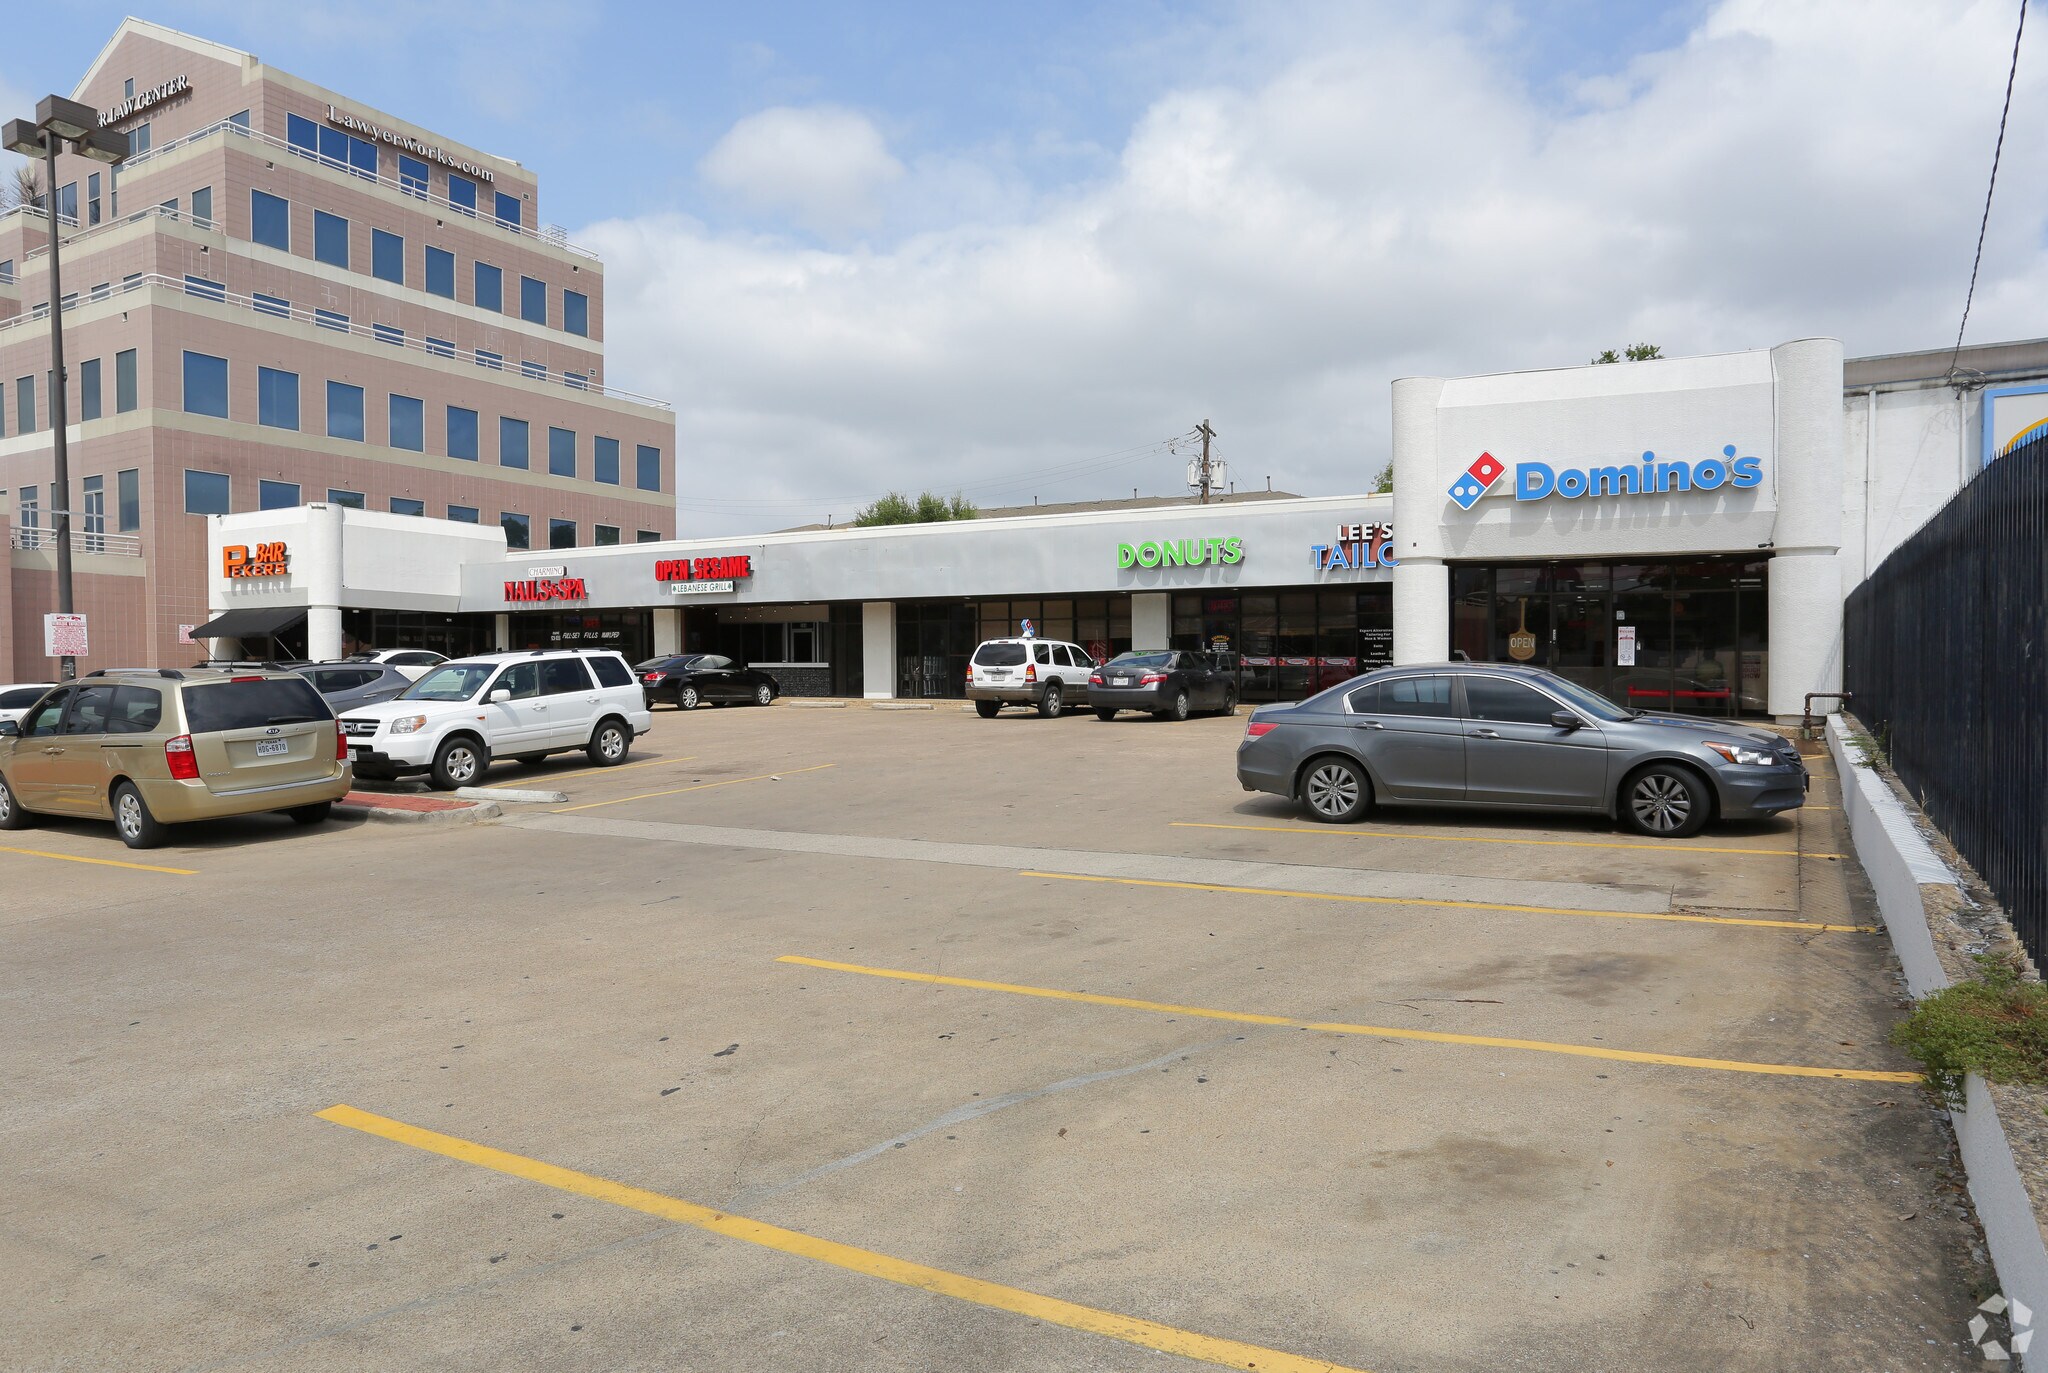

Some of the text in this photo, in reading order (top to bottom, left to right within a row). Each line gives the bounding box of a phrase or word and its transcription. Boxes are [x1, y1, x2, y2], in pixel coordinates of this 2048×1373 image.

[110, 97, 136, 122] LAW
[137, 74, 188, 109] CENTER
[327, 104, 495, 183] Lawyerworks.com
[1514, 444, 1763, 502] Domino's
[1337, 521, 1393, 541] LEE'S
[255, 541, 286, 563] BAR
[1116, 537, 1243, 569] DONUTS
[528, 567, 563, 577] CHARMING
[655, 555, 750, 581] OPEN SESAME
[677, 582, 728, 593] LEBANESE GRILL
[1510, 637, 1535, 648] OPEN
